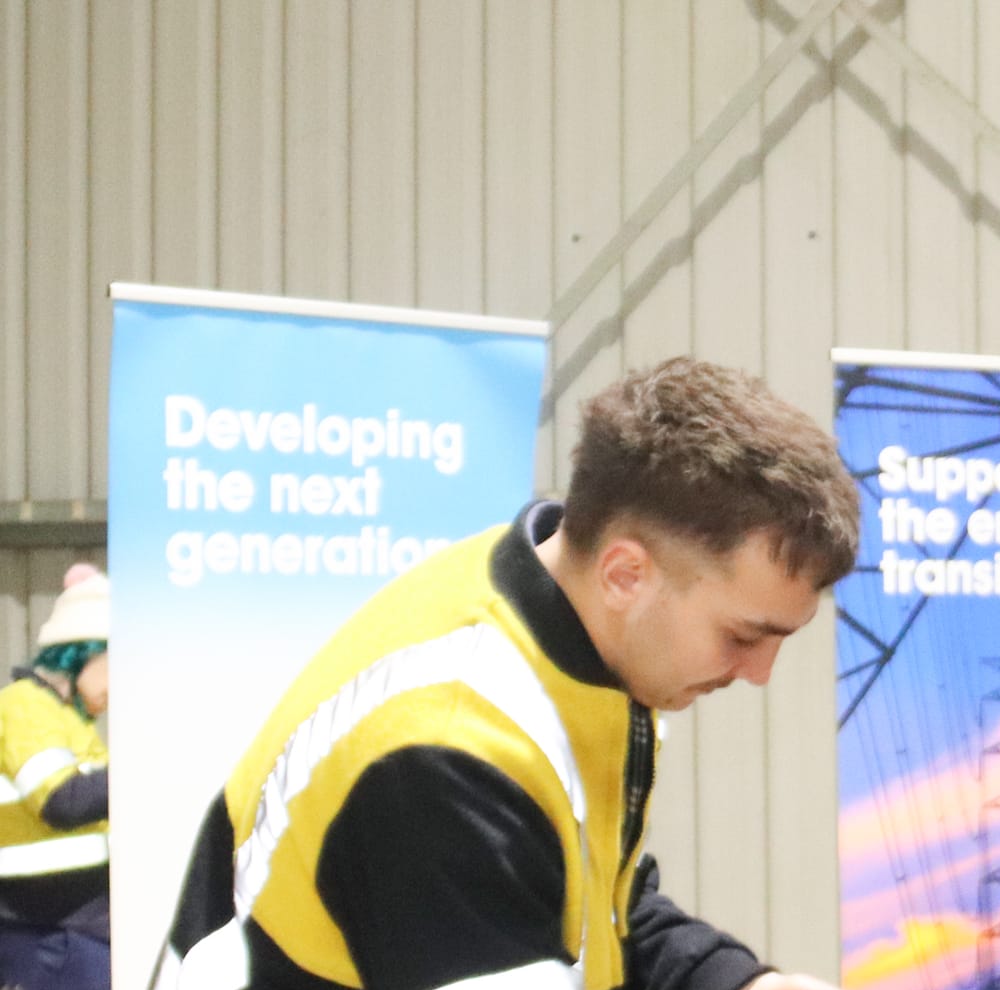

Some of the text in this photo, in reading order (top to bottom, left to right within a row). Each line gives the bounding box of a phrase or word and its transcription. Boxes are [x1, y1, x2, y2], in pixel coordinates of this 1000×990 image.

[164, 394, 464, 474] Developing
[162, 457, 382, 516] the next
[878, 498, 957, 545] the
